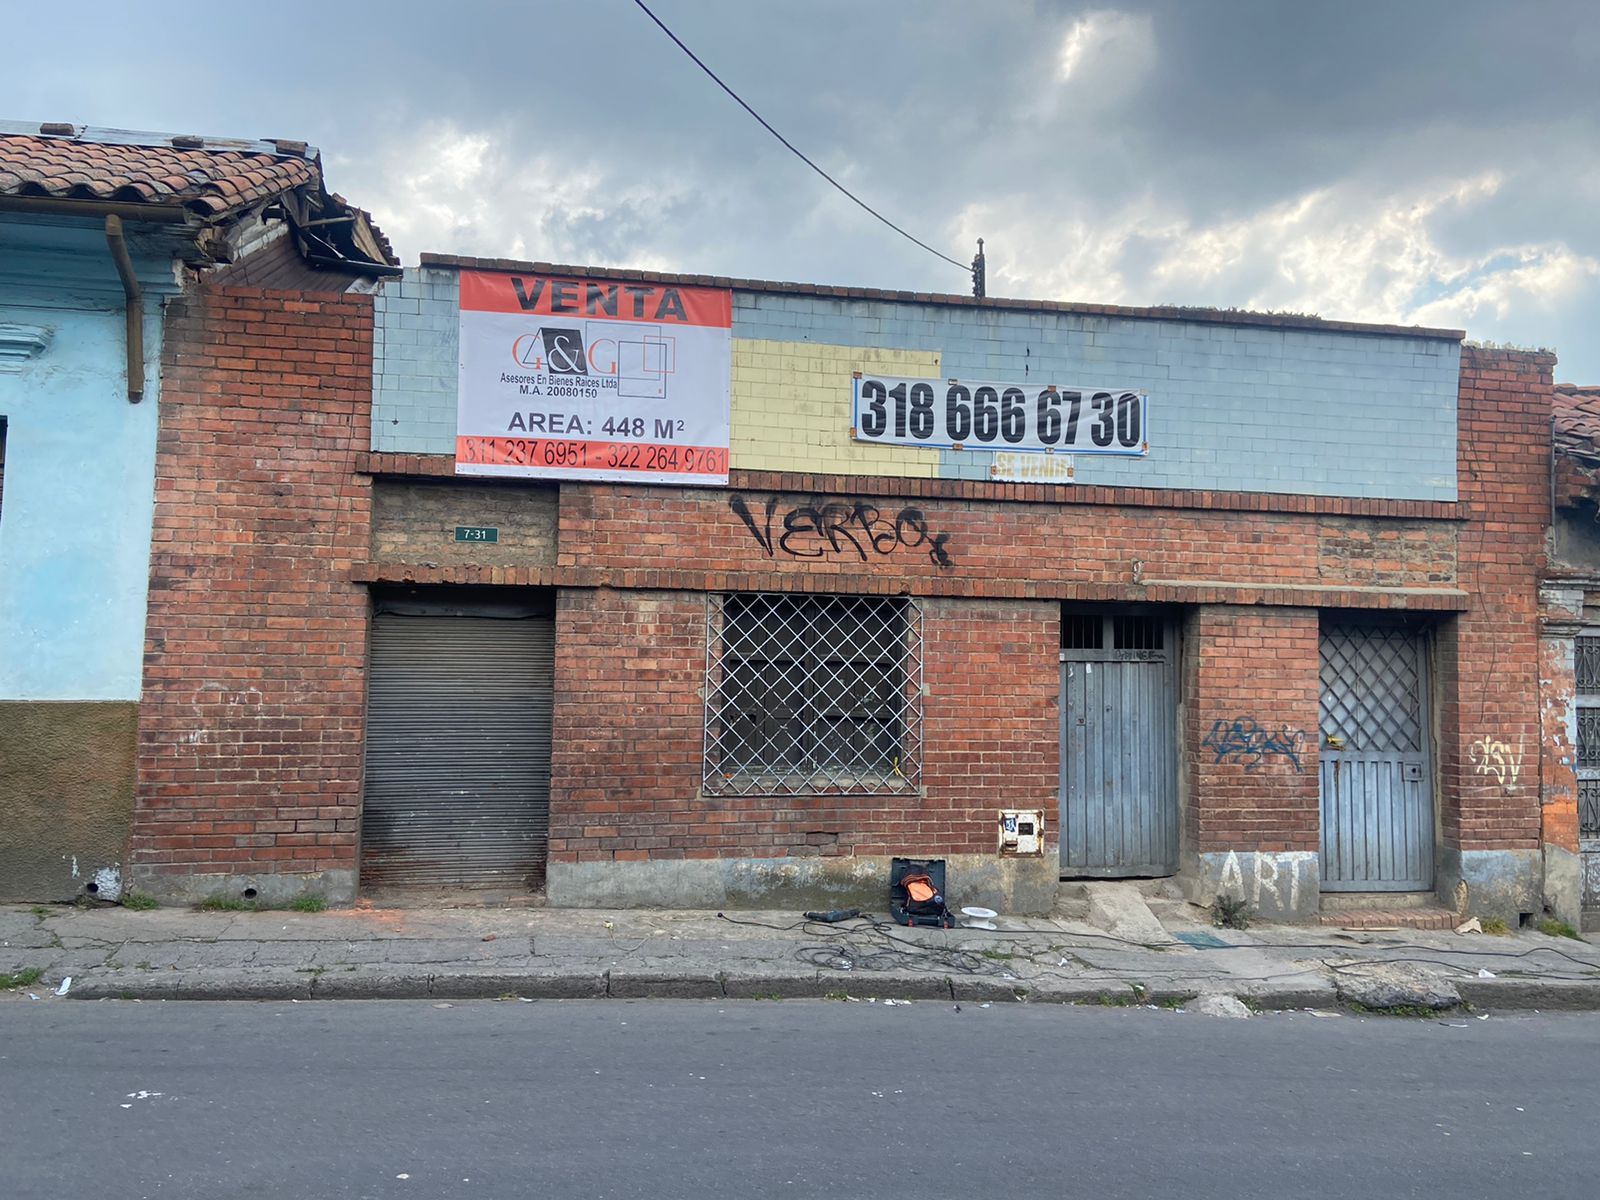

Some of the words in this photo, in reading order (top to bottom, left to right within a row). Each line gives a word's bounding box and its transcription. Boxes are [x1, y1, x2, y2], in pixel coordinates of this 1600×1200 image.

[511, 277, 688, 321] VENTA
[500, 372, 535, 385] Asesores
[537, 374, 547, 385] En
[549, 375, 574, 387] Bienes
[575, 376, 600, 388] Raices
[601, 378, 617, 389] Ltda
[519, 385, 543, 396] M.A.
[547, 386, 597, 398] 20080150
[507, 411, 592, 435] AREA:
[601, 416, 645, 438] 448
[861, 380, 934, 439] 318
[946, 384, 1026, 444] 666
[465, 438, 496, 464] 311
[504, 439, 538, 465] 237
[544, 440, 588, 466] 6951
[607, 444, 640, 469] 322
[646, 445, 678, 470] 264
[684, 447, 726, 473] 9761
[464, 529, 486, 539] 7-31
[1216, 849, 1314, 912] ART
